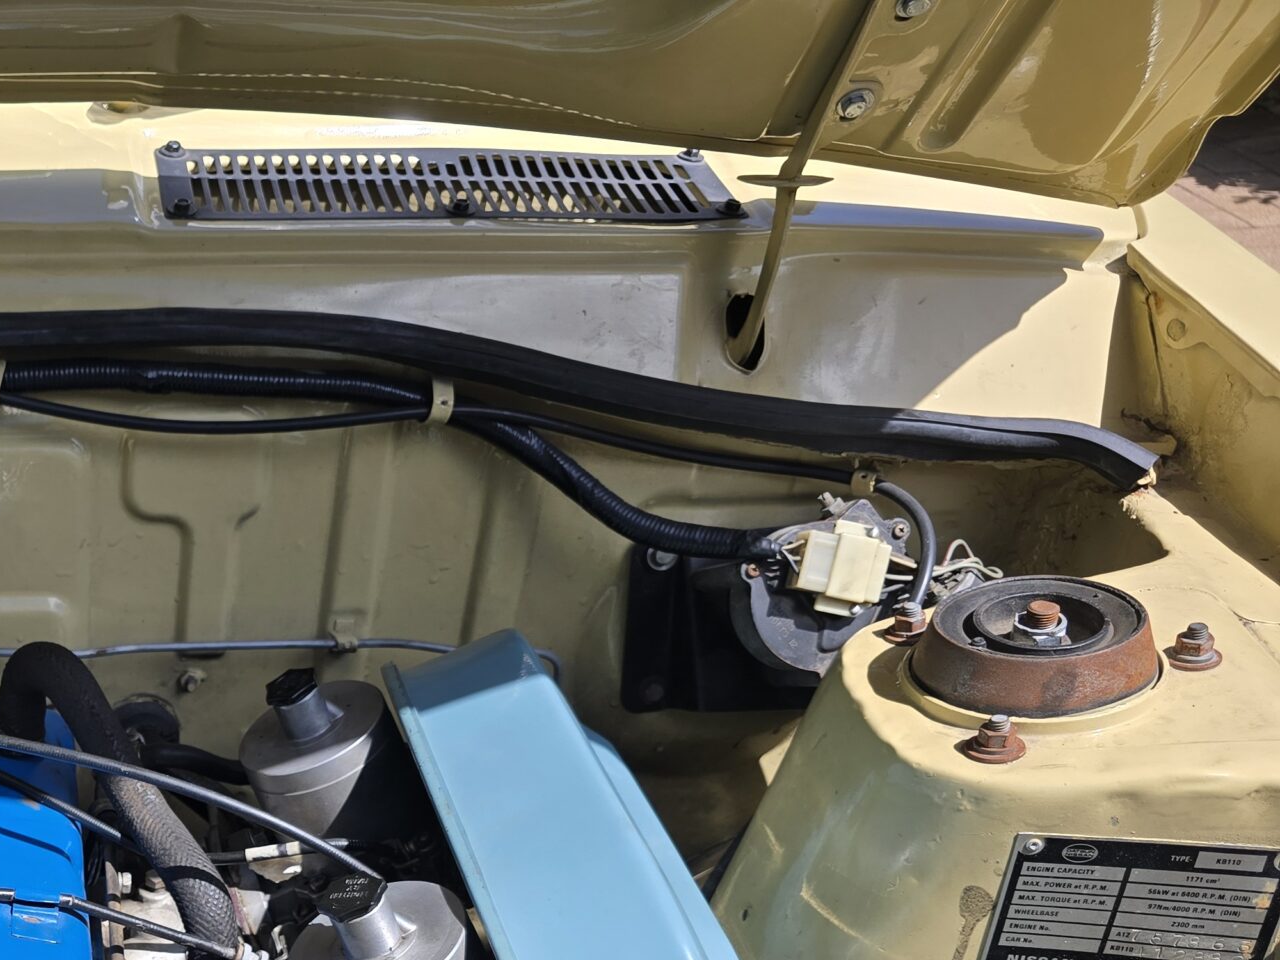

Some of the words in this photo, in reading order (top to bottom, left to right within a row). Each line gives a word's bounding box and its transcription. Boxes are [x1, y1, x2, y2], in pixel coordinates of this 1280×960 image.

[1057, 867, 1096, 875] CAPACITY
[1044, 881, 1072, 889] POWER
[1040, 895, 1072, 904] TORQUE
[1014, 908, 1060, 917] WHEELBASE
[1009, 922, 1038, 930] ENGINE
